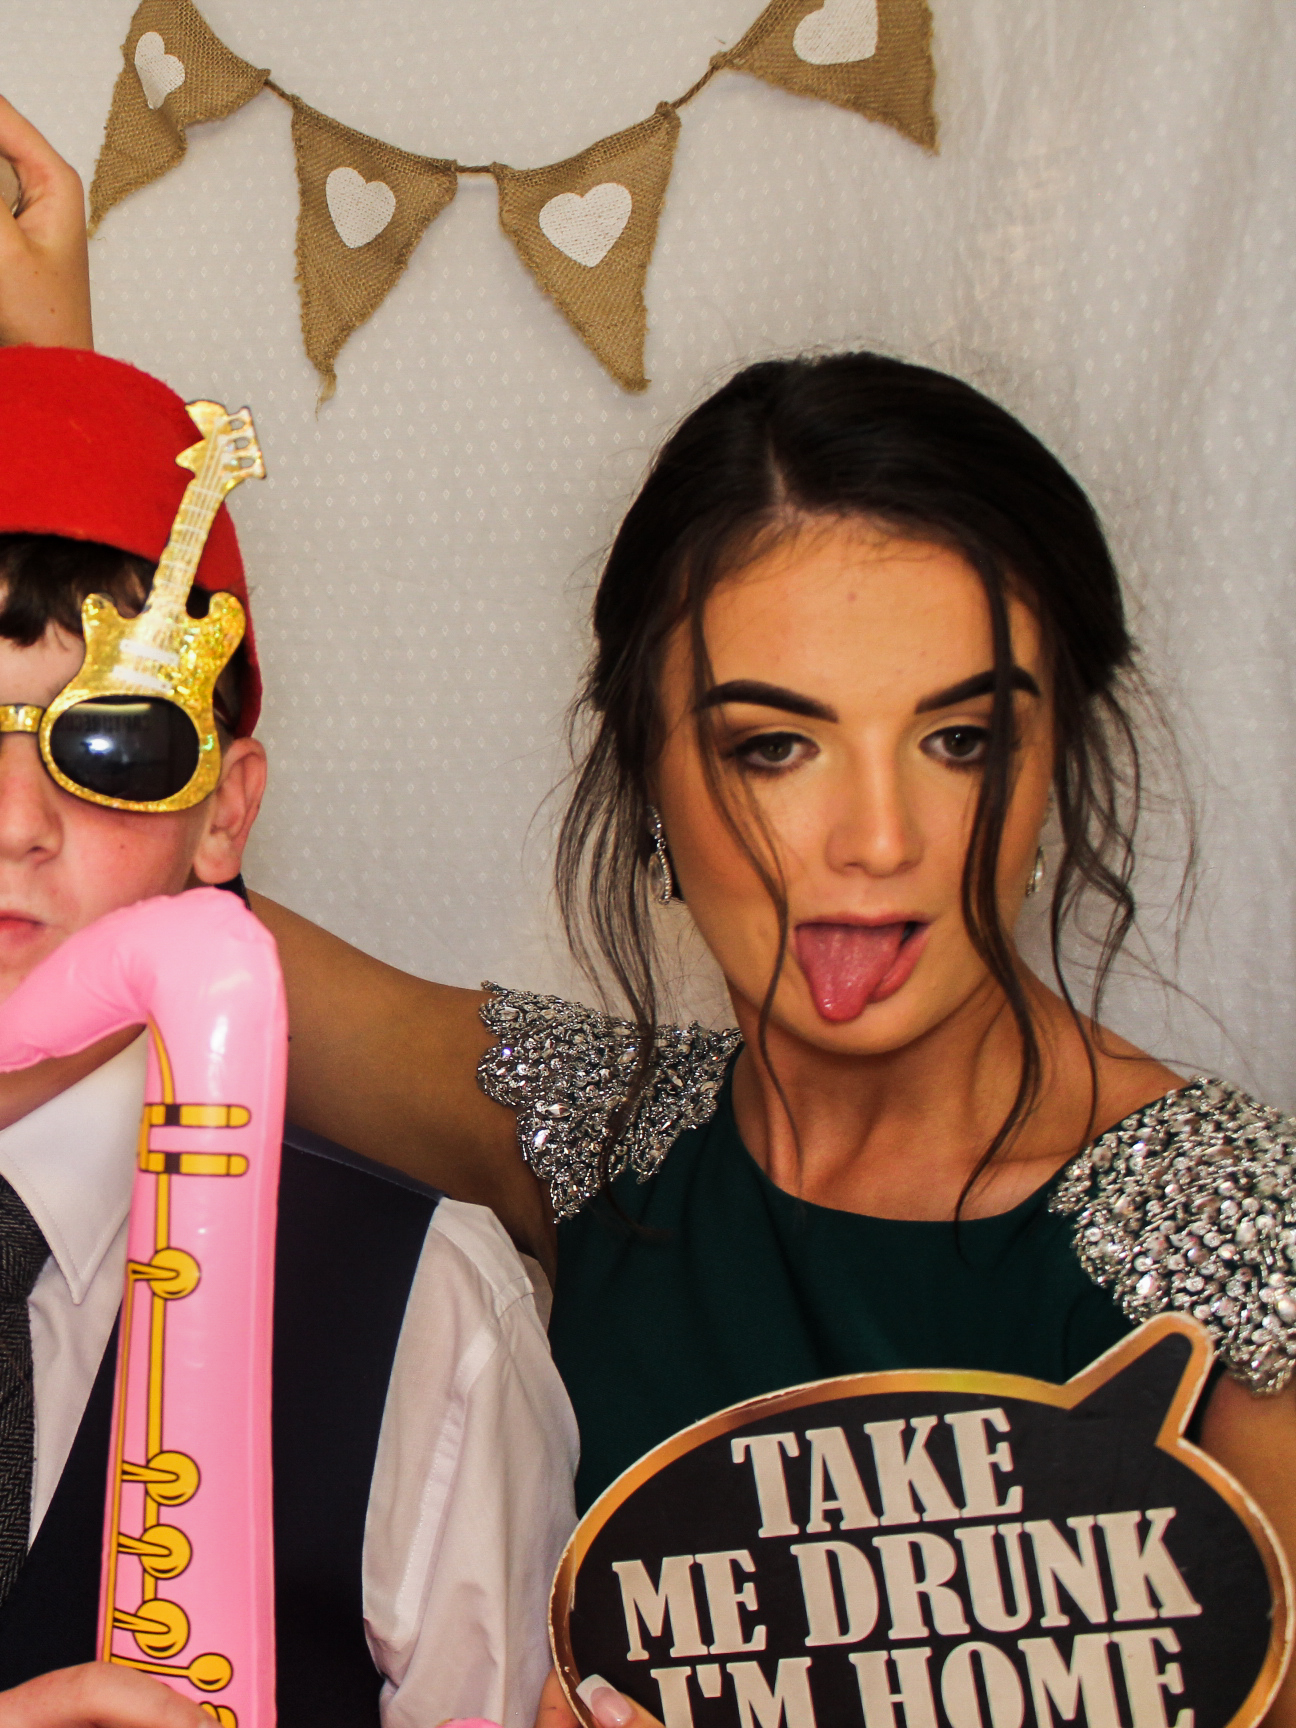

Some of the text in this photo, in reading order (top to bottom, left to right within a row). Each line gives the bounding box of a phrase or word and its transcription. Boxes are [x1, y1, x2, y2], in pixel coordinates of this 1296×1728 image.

[732, 1408, 1022, 1537] TAKE
[613, 1508, 1202, 1660] ME DRUNK
[651, 1628, 1193, 1728] I'M HOME
